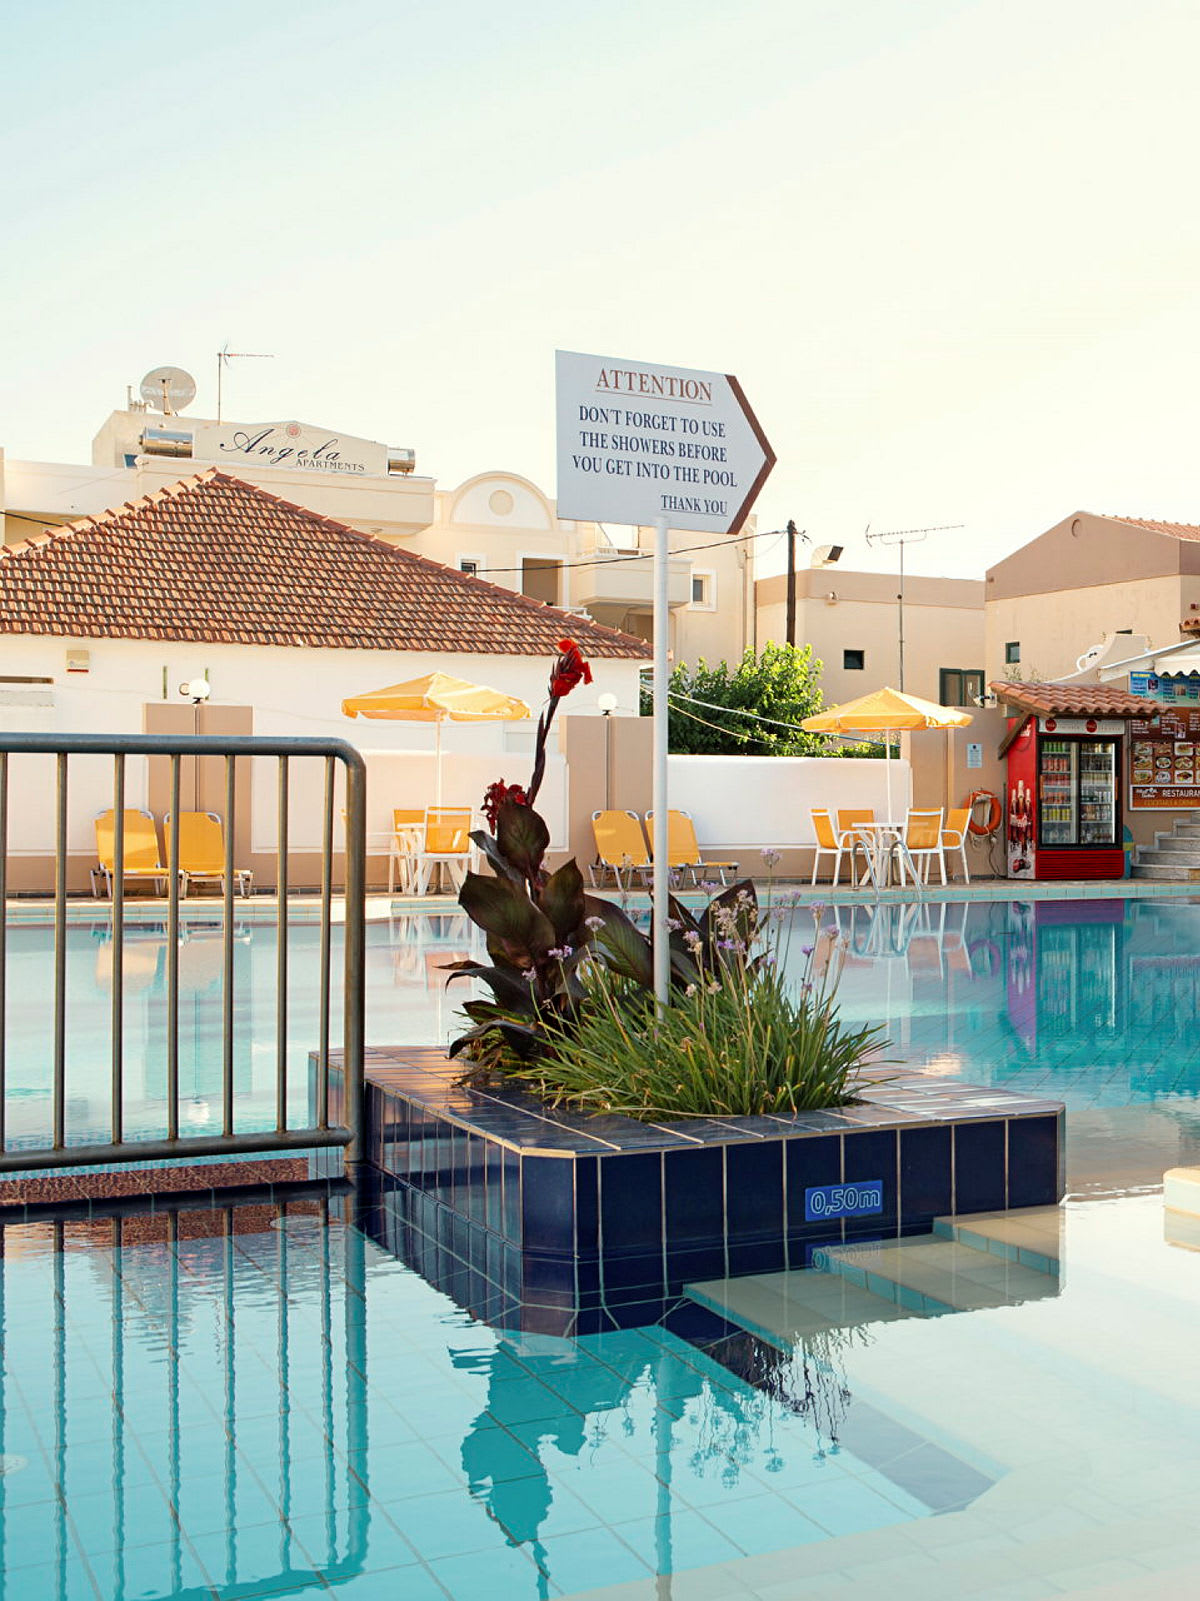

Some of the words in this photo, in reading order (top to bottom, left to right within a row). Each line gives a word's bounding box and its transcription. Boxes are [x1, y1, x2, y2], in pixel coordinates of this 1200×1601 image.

[596, 368, 712, 401] ATTENTION
[625, 411, 677, 432] FORGET
[680, 418, 699, 435] TO
[702, 420, 726, 438] USE
[219, 428, 341, 465] Angela
[579, 431, 608, 449] THE
[611, 435, 675, 456] SHOWERS
[678, 442, 727, 463] BEFORE
[296, 459, 365, 472] APARTMENTS
[572, 455, 602, 473] YOU
[606, 459, 633, 476] GET
[637, 462, 670, 480] INTO
[673, 466, 700, 483] THE
[703, 470, 738, 487] POOL
[661, 495, 702, 512] THANK
[704, 499, 728, 514] YOU
[810, 1187, 880, 1216] 0,50m
